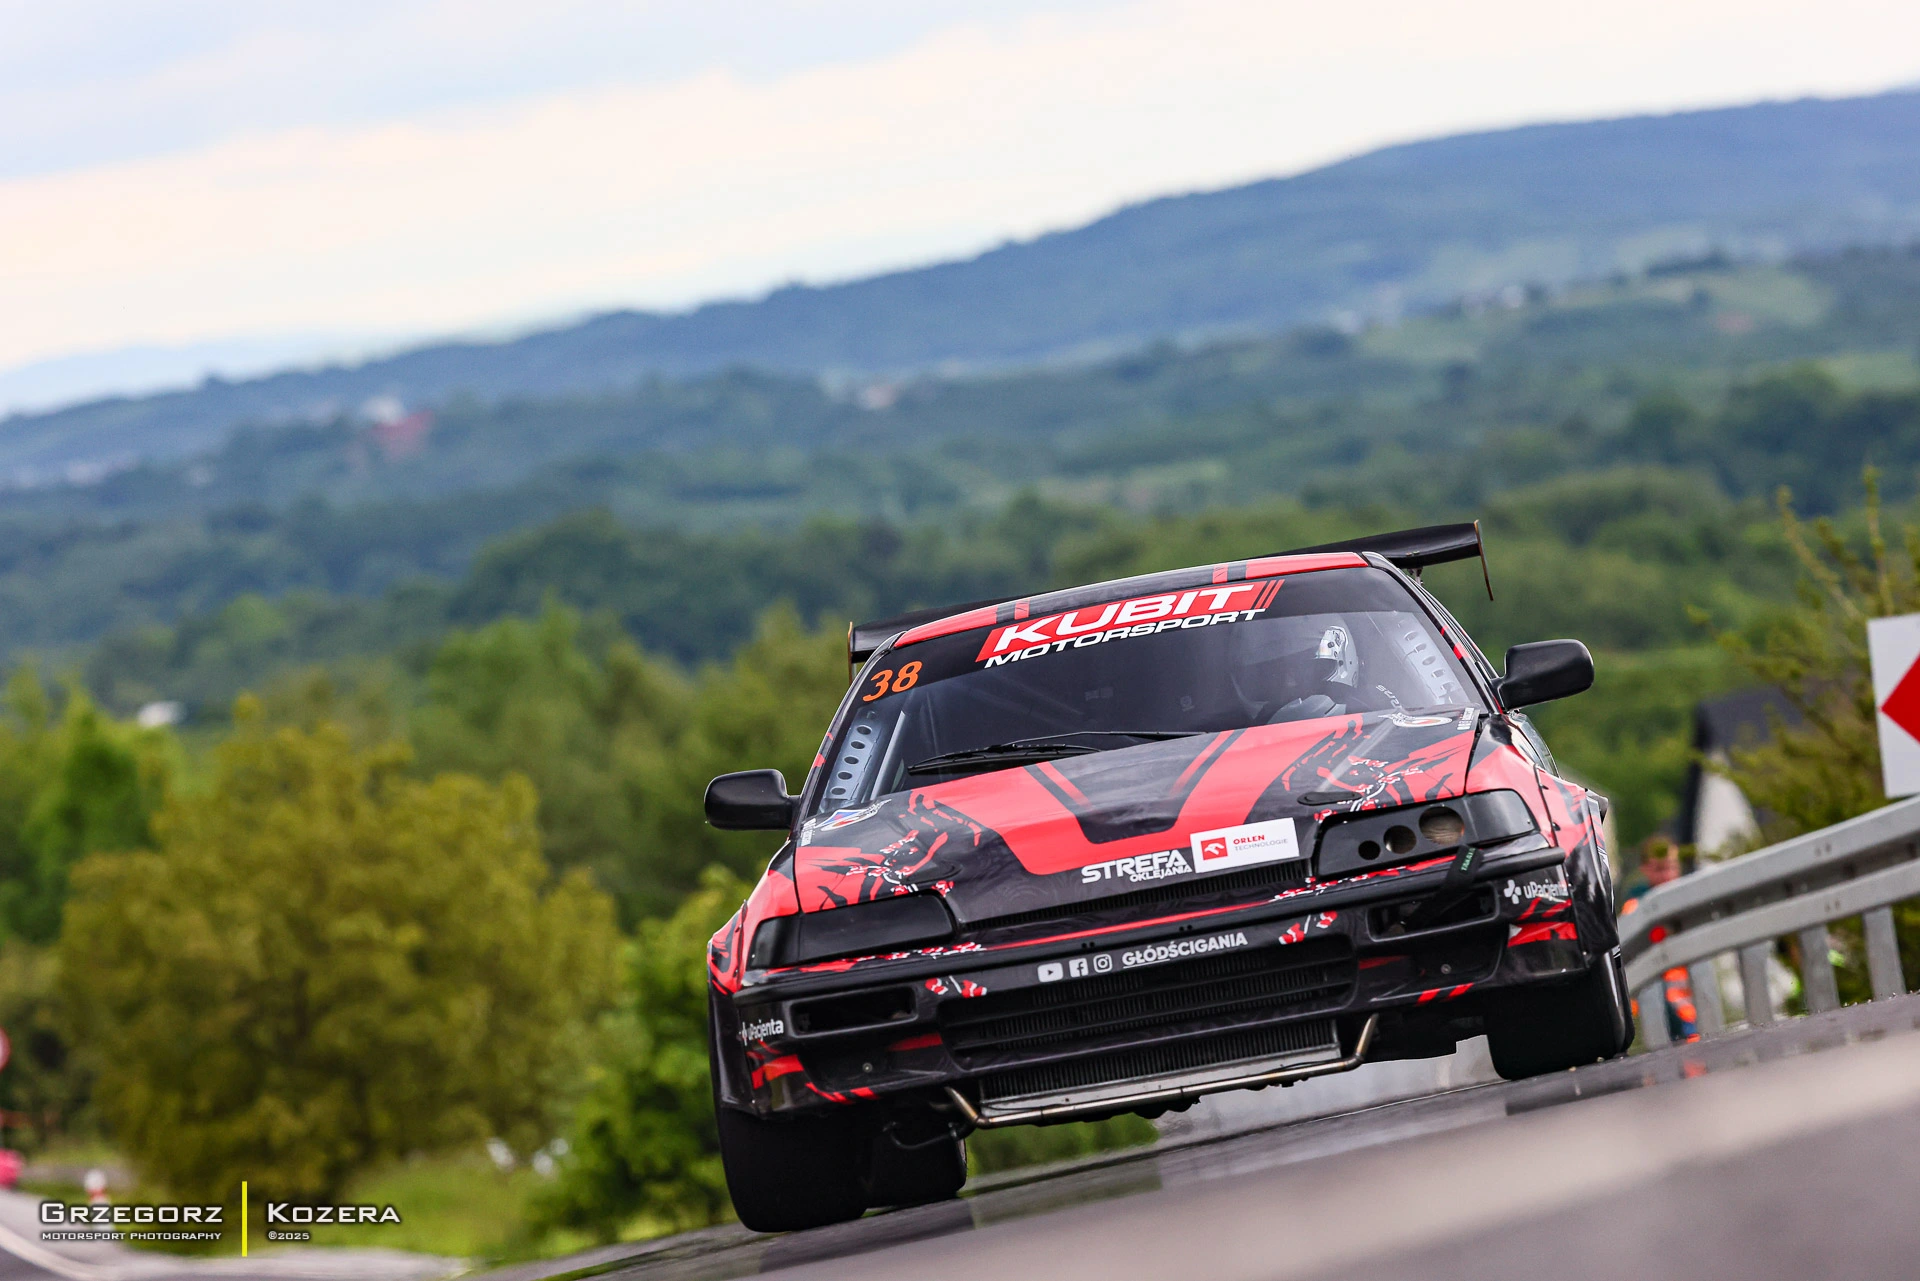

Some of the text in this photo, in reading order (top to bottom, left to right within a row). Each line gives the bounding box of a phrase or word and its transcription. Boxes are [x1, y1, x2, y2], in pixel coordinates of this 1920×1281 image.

[993, 584, 1255, 653] KUBIT
[984, 608, 1266, 669] MOTORSPORT
[862, 660, 923, 702] 38
[1233, 834, 1266, 845] ORLEN
[1234, 838, 1289, 852] TECHNOLOGIE
[1081, 849, 1189, 884] STREFA
[1129, 864, 1193, 883] OKLEJANIA
[1121, 932, 1249, 967] GŁÓDŚCIGANIA
